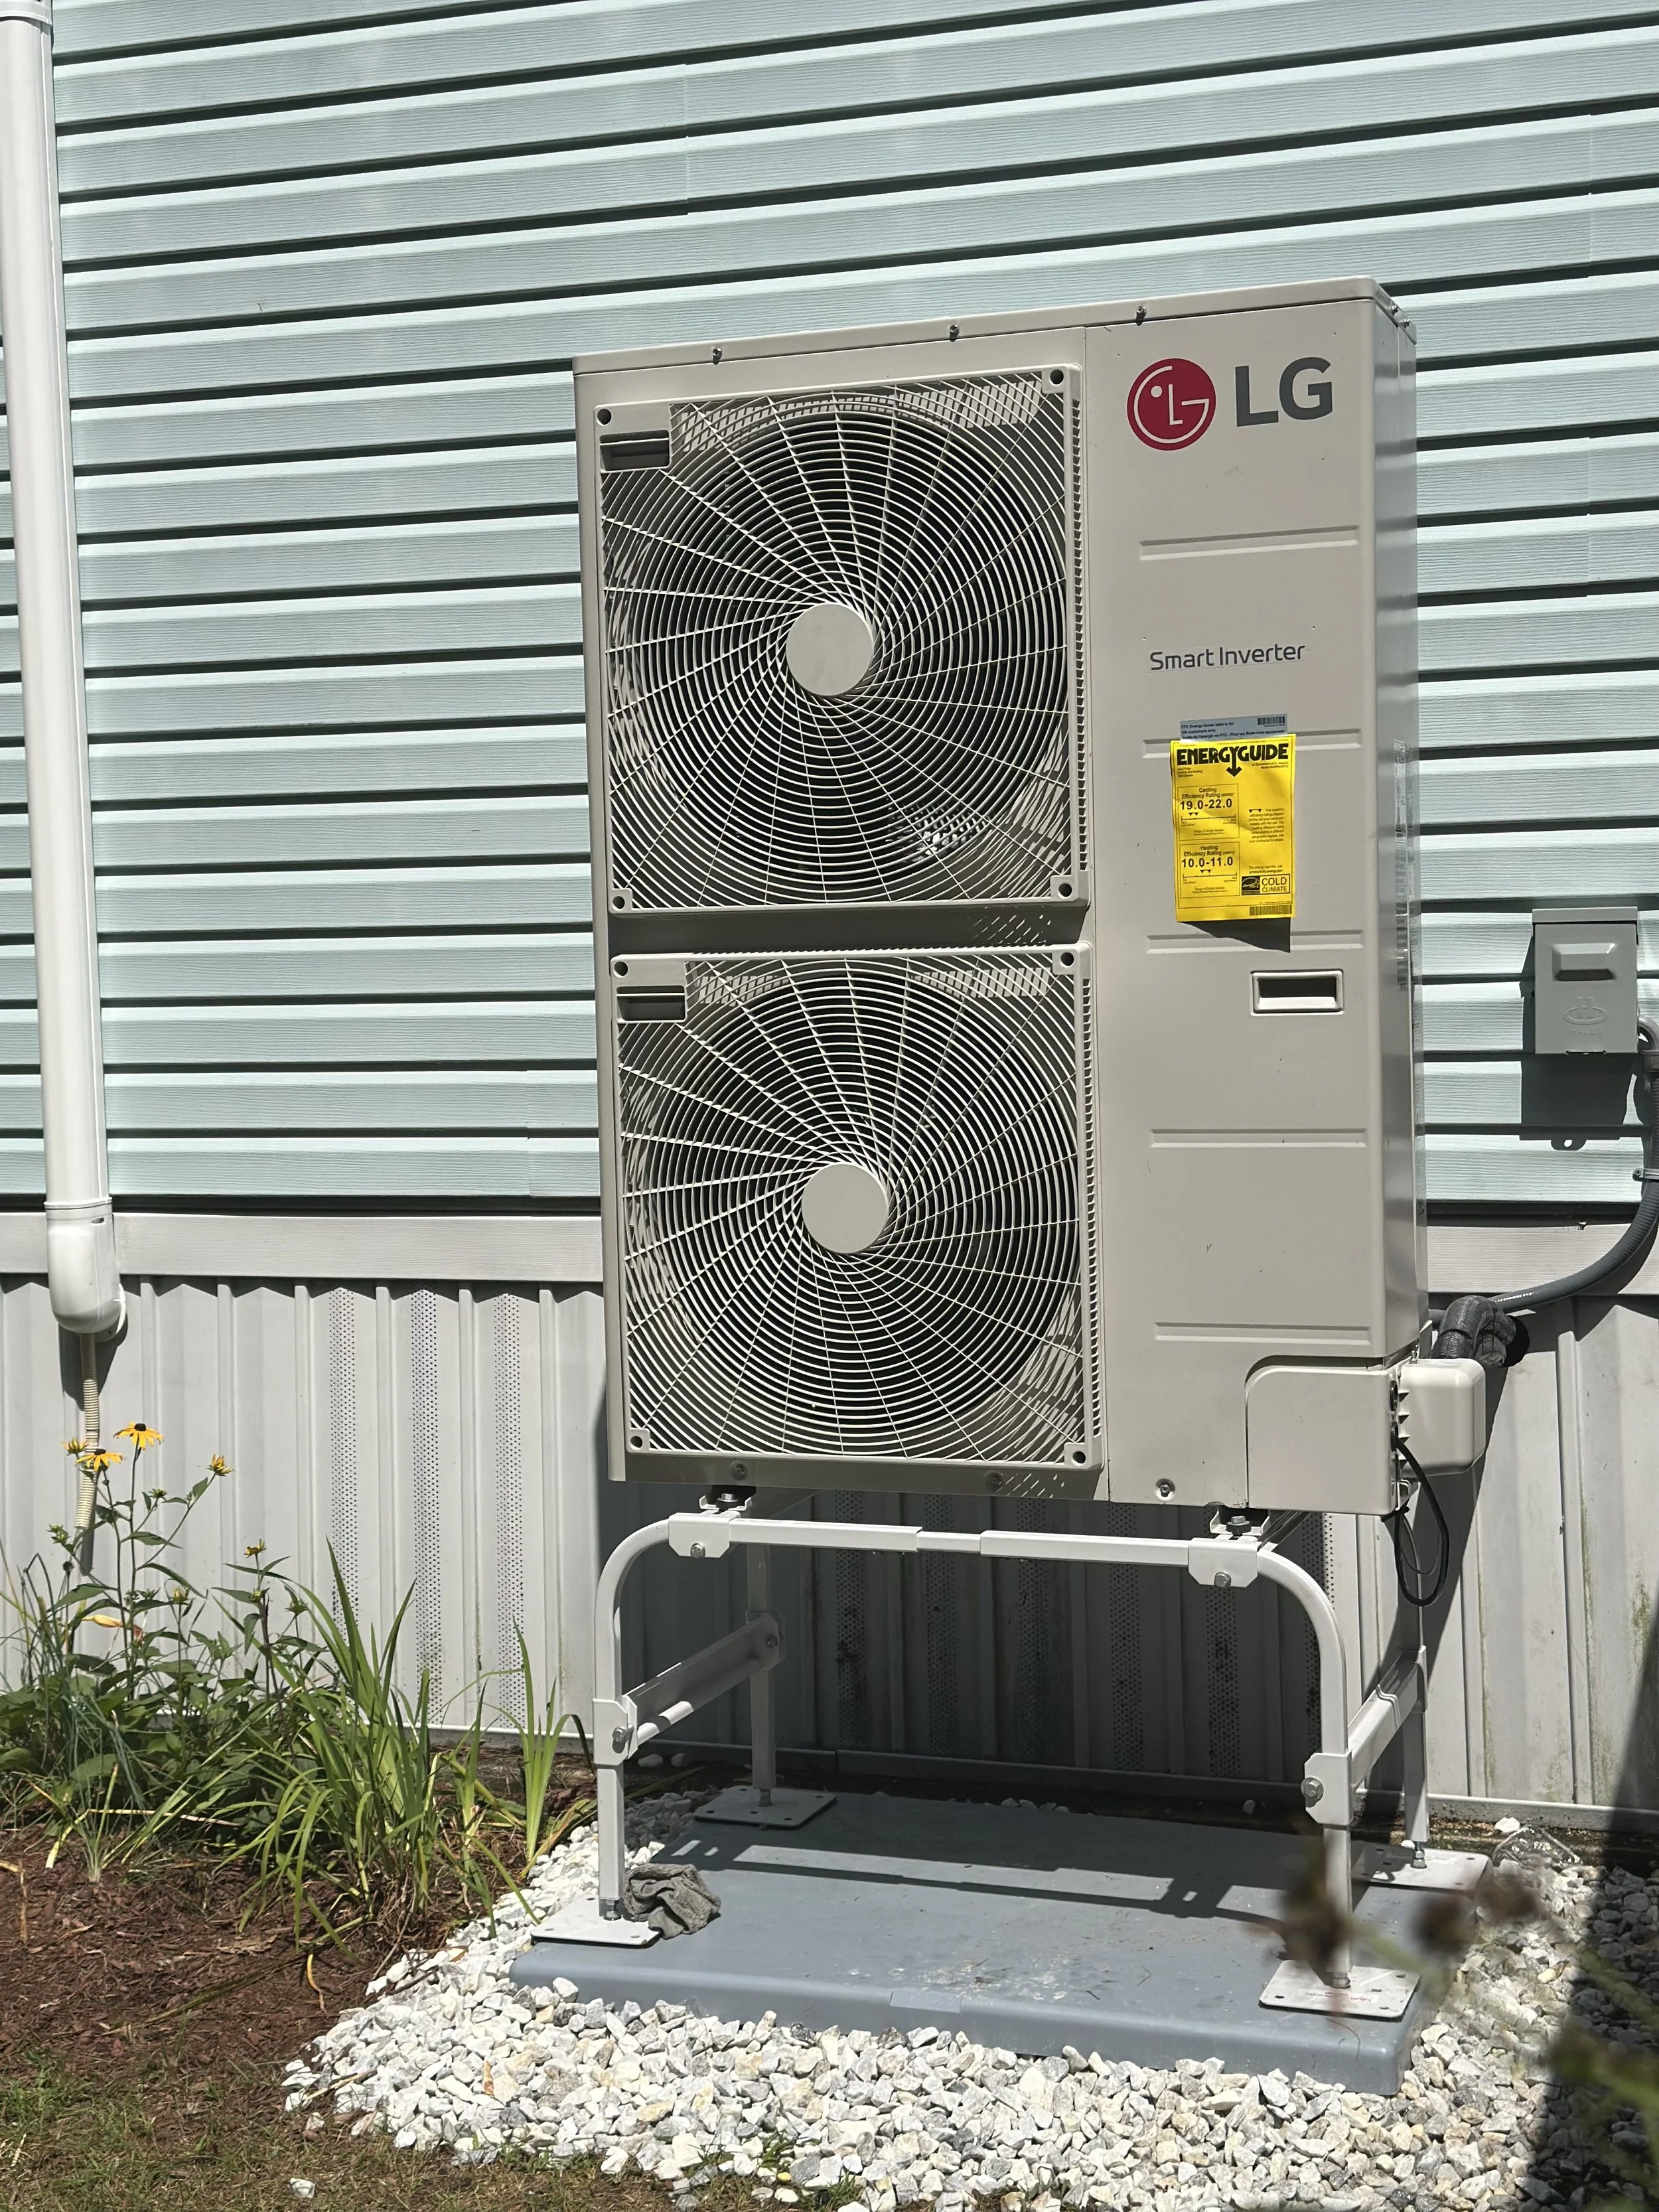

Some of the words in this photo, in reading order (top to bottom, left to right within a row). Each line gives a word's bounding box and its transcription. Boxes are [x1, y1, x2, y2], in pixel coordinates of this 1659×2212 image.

[1235, 356, 1333, 427] LG
[1150, 648, 1214, 670] Smart
[1220, 644, 1306, 666] Inverter
[1177, 743, 1289, 767] ENERGYGUIDE
[1180, 798, 1232, 810] 19.0-22.0
[1181, 856, 1234, 868] 10.0-11.0
[1262, 877, 1287, 886] COLD
